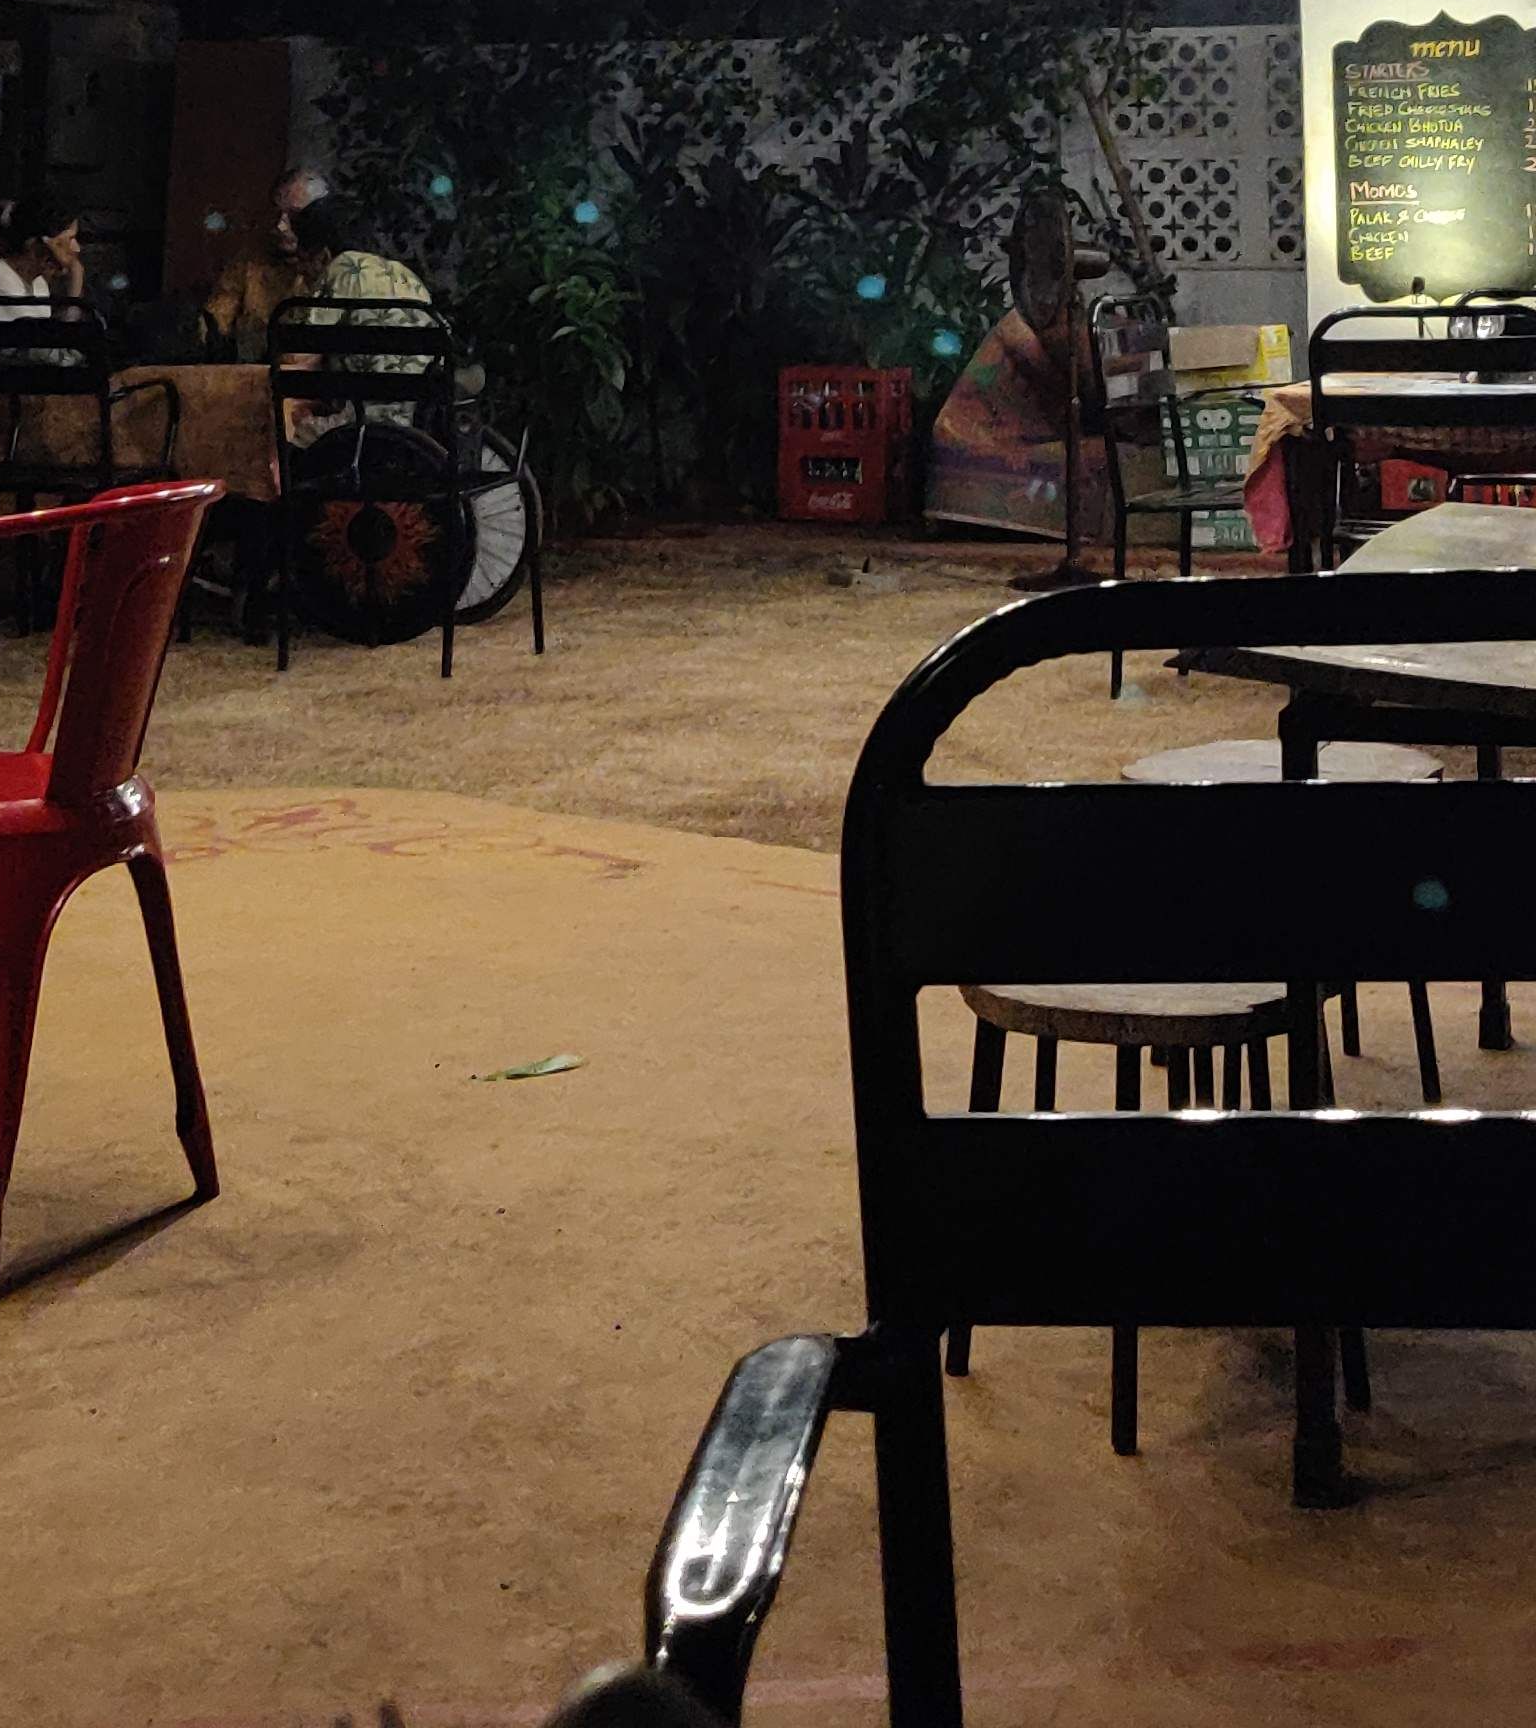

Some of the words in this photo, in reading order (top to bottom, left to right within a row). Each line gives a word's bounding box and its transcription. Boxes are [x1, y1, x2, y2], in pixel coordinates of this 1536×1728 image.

[1410, 39, 1481, 58] menu
[1417, 82, 1461, 102] FRIES
[1347, 102, 1393, 118] FRIED
[1448, 155, 1477, 175] FRY
[1349, 207, 1392, 226] PALAK
[1350, 247, 1395, 262] BEEF
